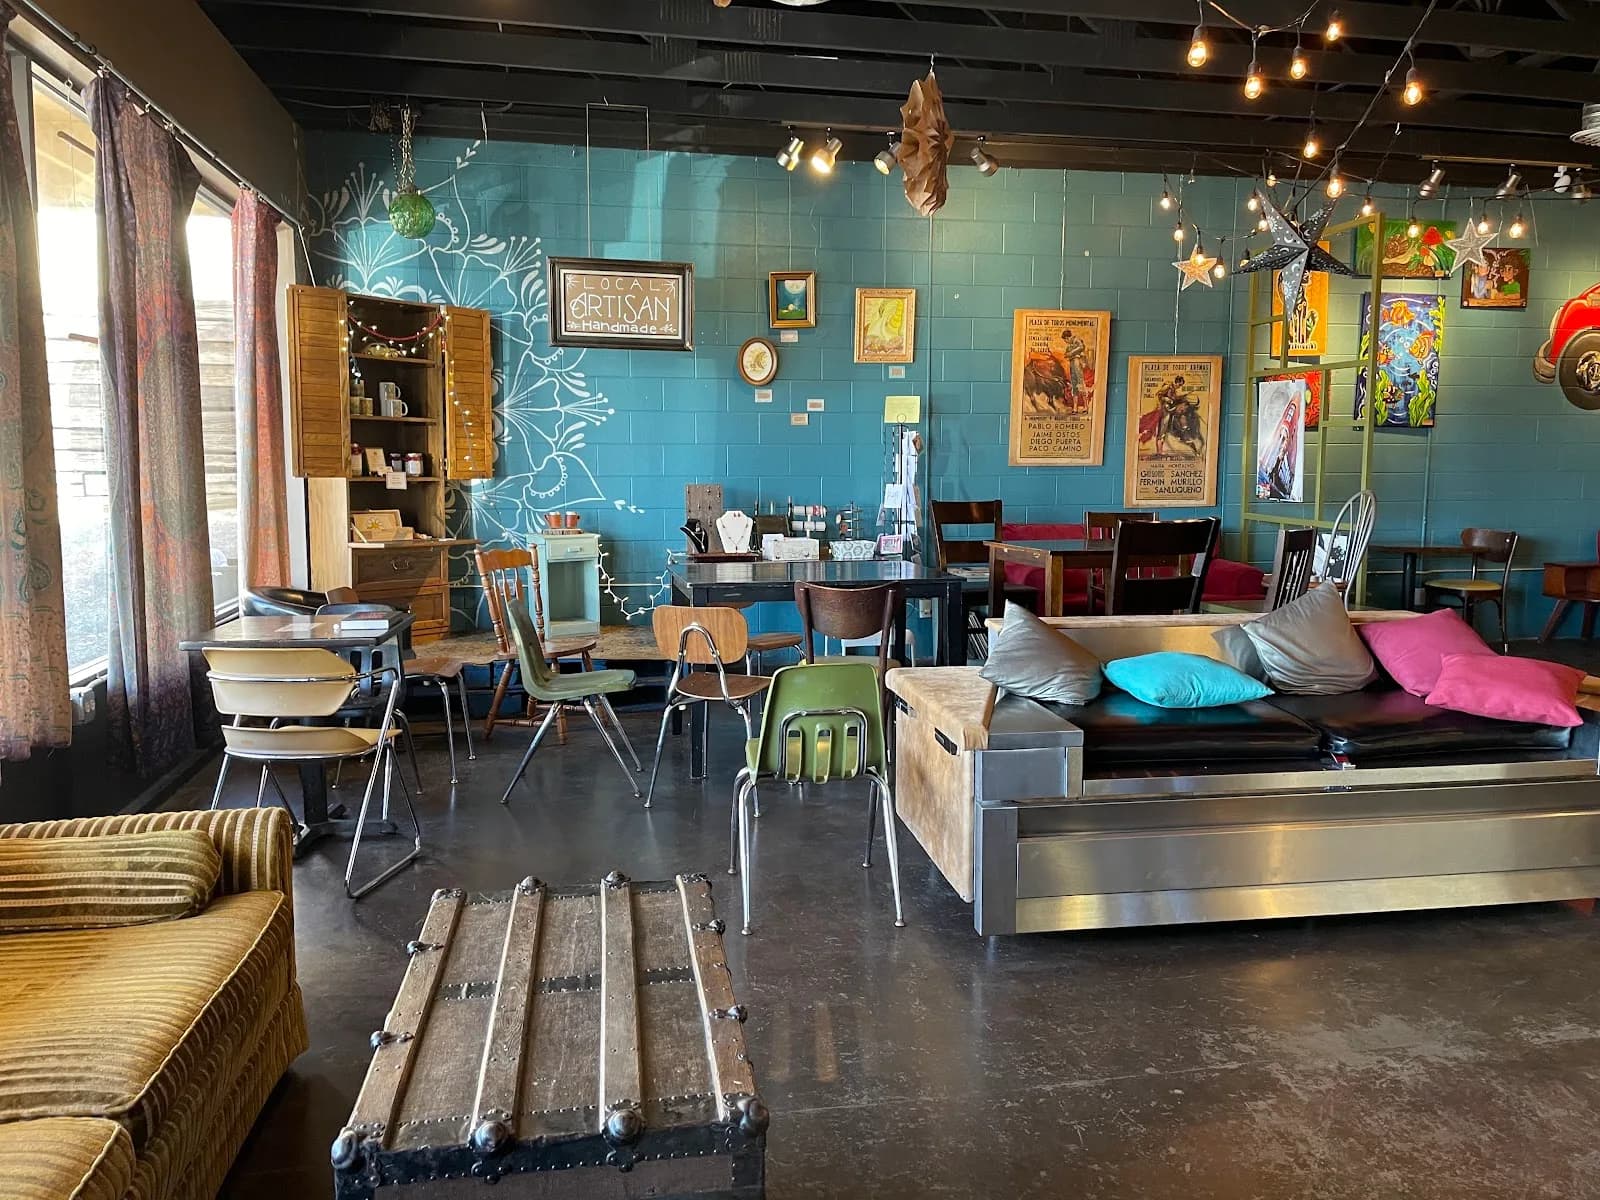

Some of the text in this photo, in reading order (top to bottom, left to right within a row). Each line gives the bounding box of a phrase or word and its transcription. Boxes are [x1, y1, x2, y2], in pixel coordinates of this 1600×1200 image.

[583, 276, 661, 292] LOCAL
[569, 292, 670, 324] ARTISAN
[582, 320, 657, 334] Handmade
[1170, 470, 1203, 478] SANCHEZ
[1139, 478, 1203, 486] FERMIN MURILLO
